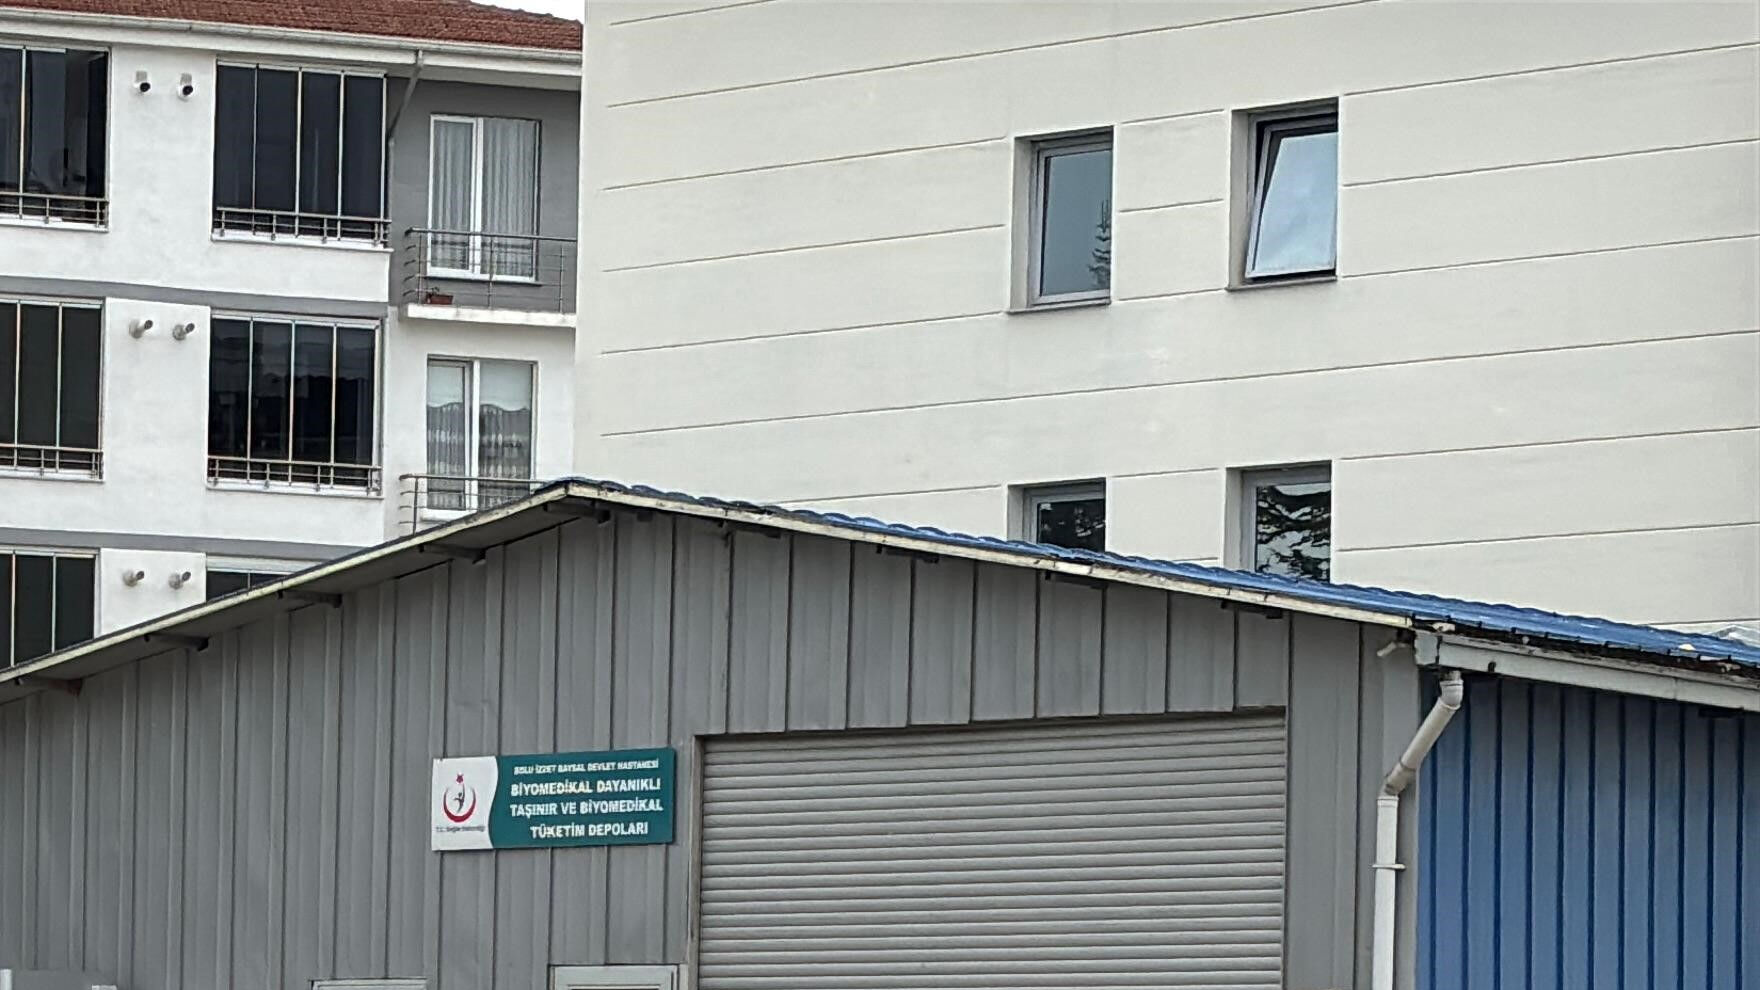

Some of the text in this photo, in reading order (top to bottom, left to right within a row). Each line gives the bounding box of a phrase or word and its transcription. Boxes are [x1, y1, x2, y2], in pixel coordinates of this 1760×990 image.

[510, 778, 661, 796] BİYOMEDİKAL DAYANIKLI
[510, 797, 664, 819] TAŞINIR VE BİYOMEDİKAL
[530, 821, 648, 839] TÜKETİM DEPOLARI
